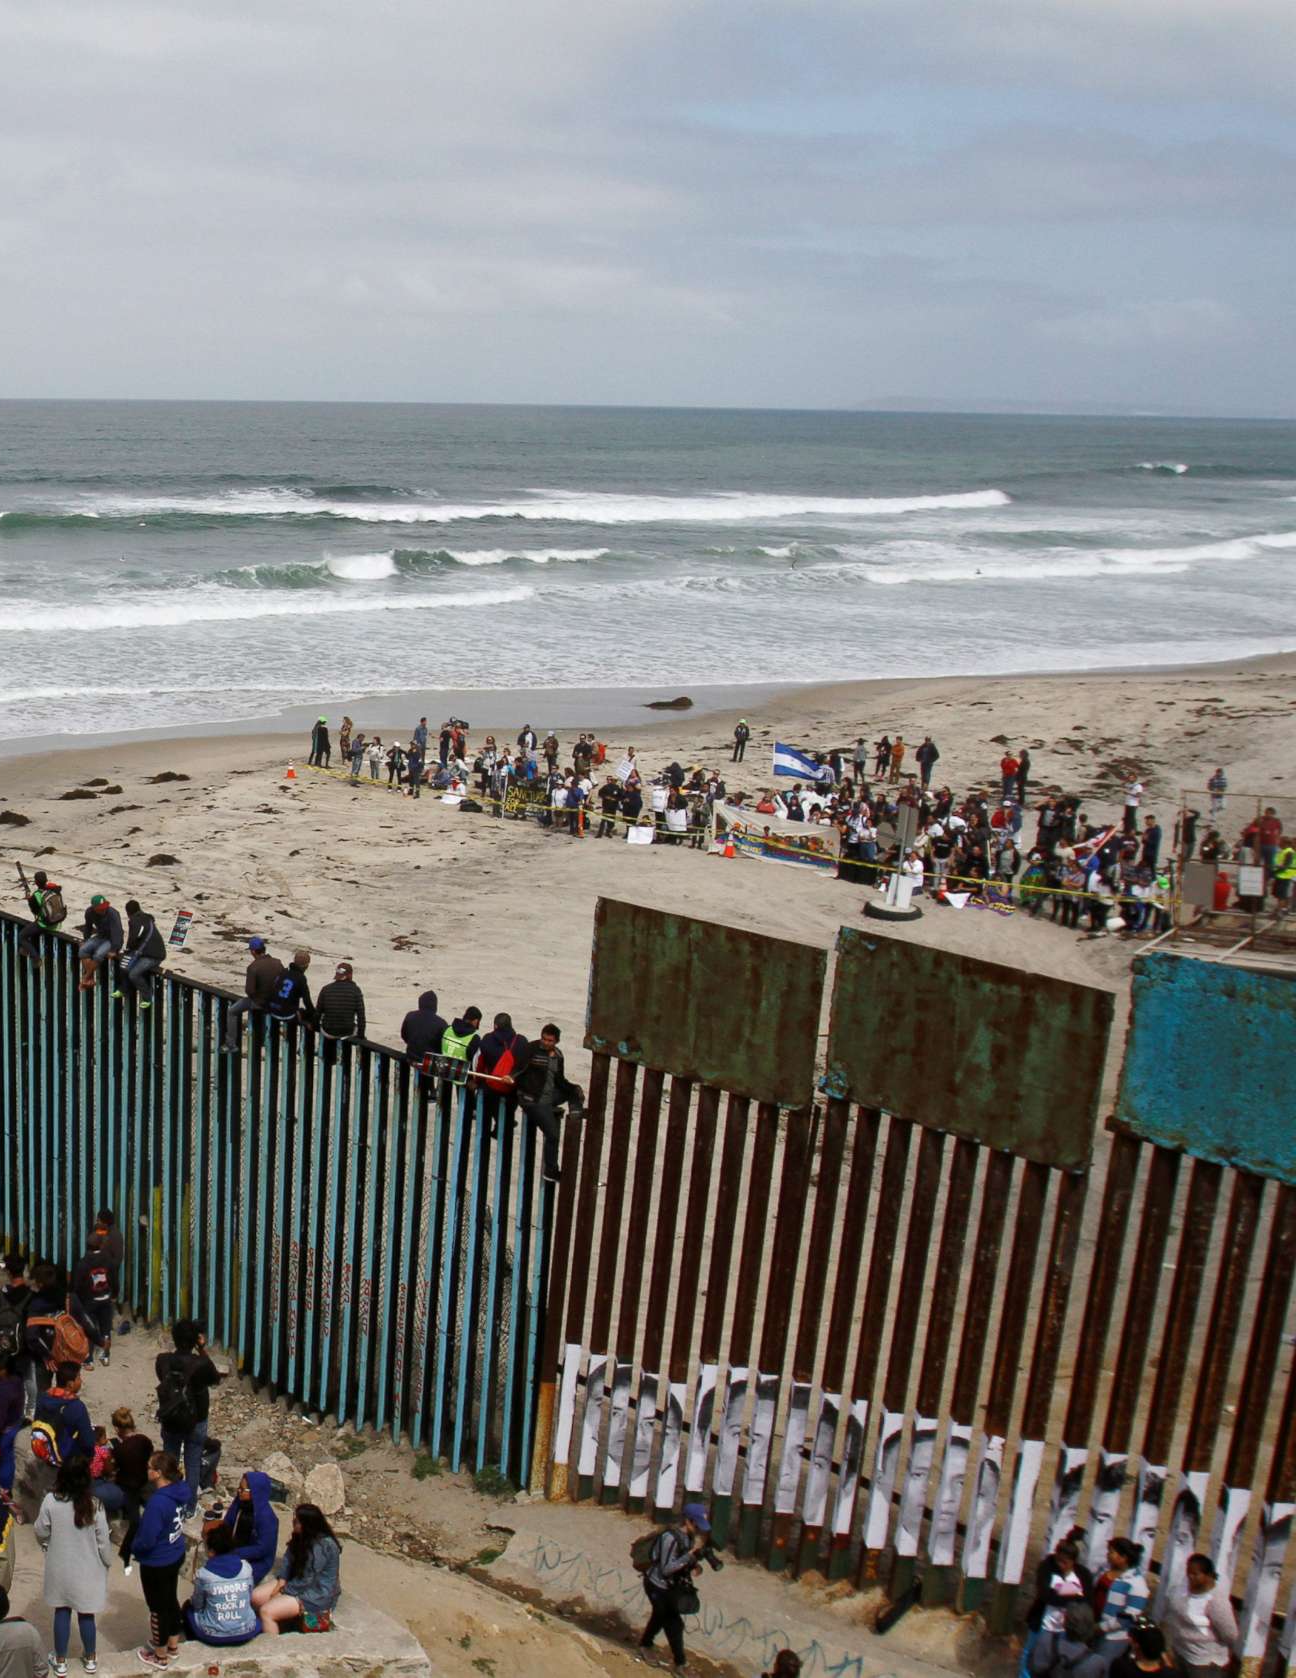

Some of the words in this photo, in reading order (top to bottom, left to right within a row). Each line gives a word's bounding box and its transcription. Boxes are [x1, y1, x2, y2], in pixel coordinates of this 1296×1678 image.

[279, 979, 293, 998] 3
[213, 1583, 248, 1595] J'ADORE
[225, 1593, 238, 1602] LE
[215, 1600, 238, 1612] ROCK
[218, 1611, 241, 1621] ROLL
